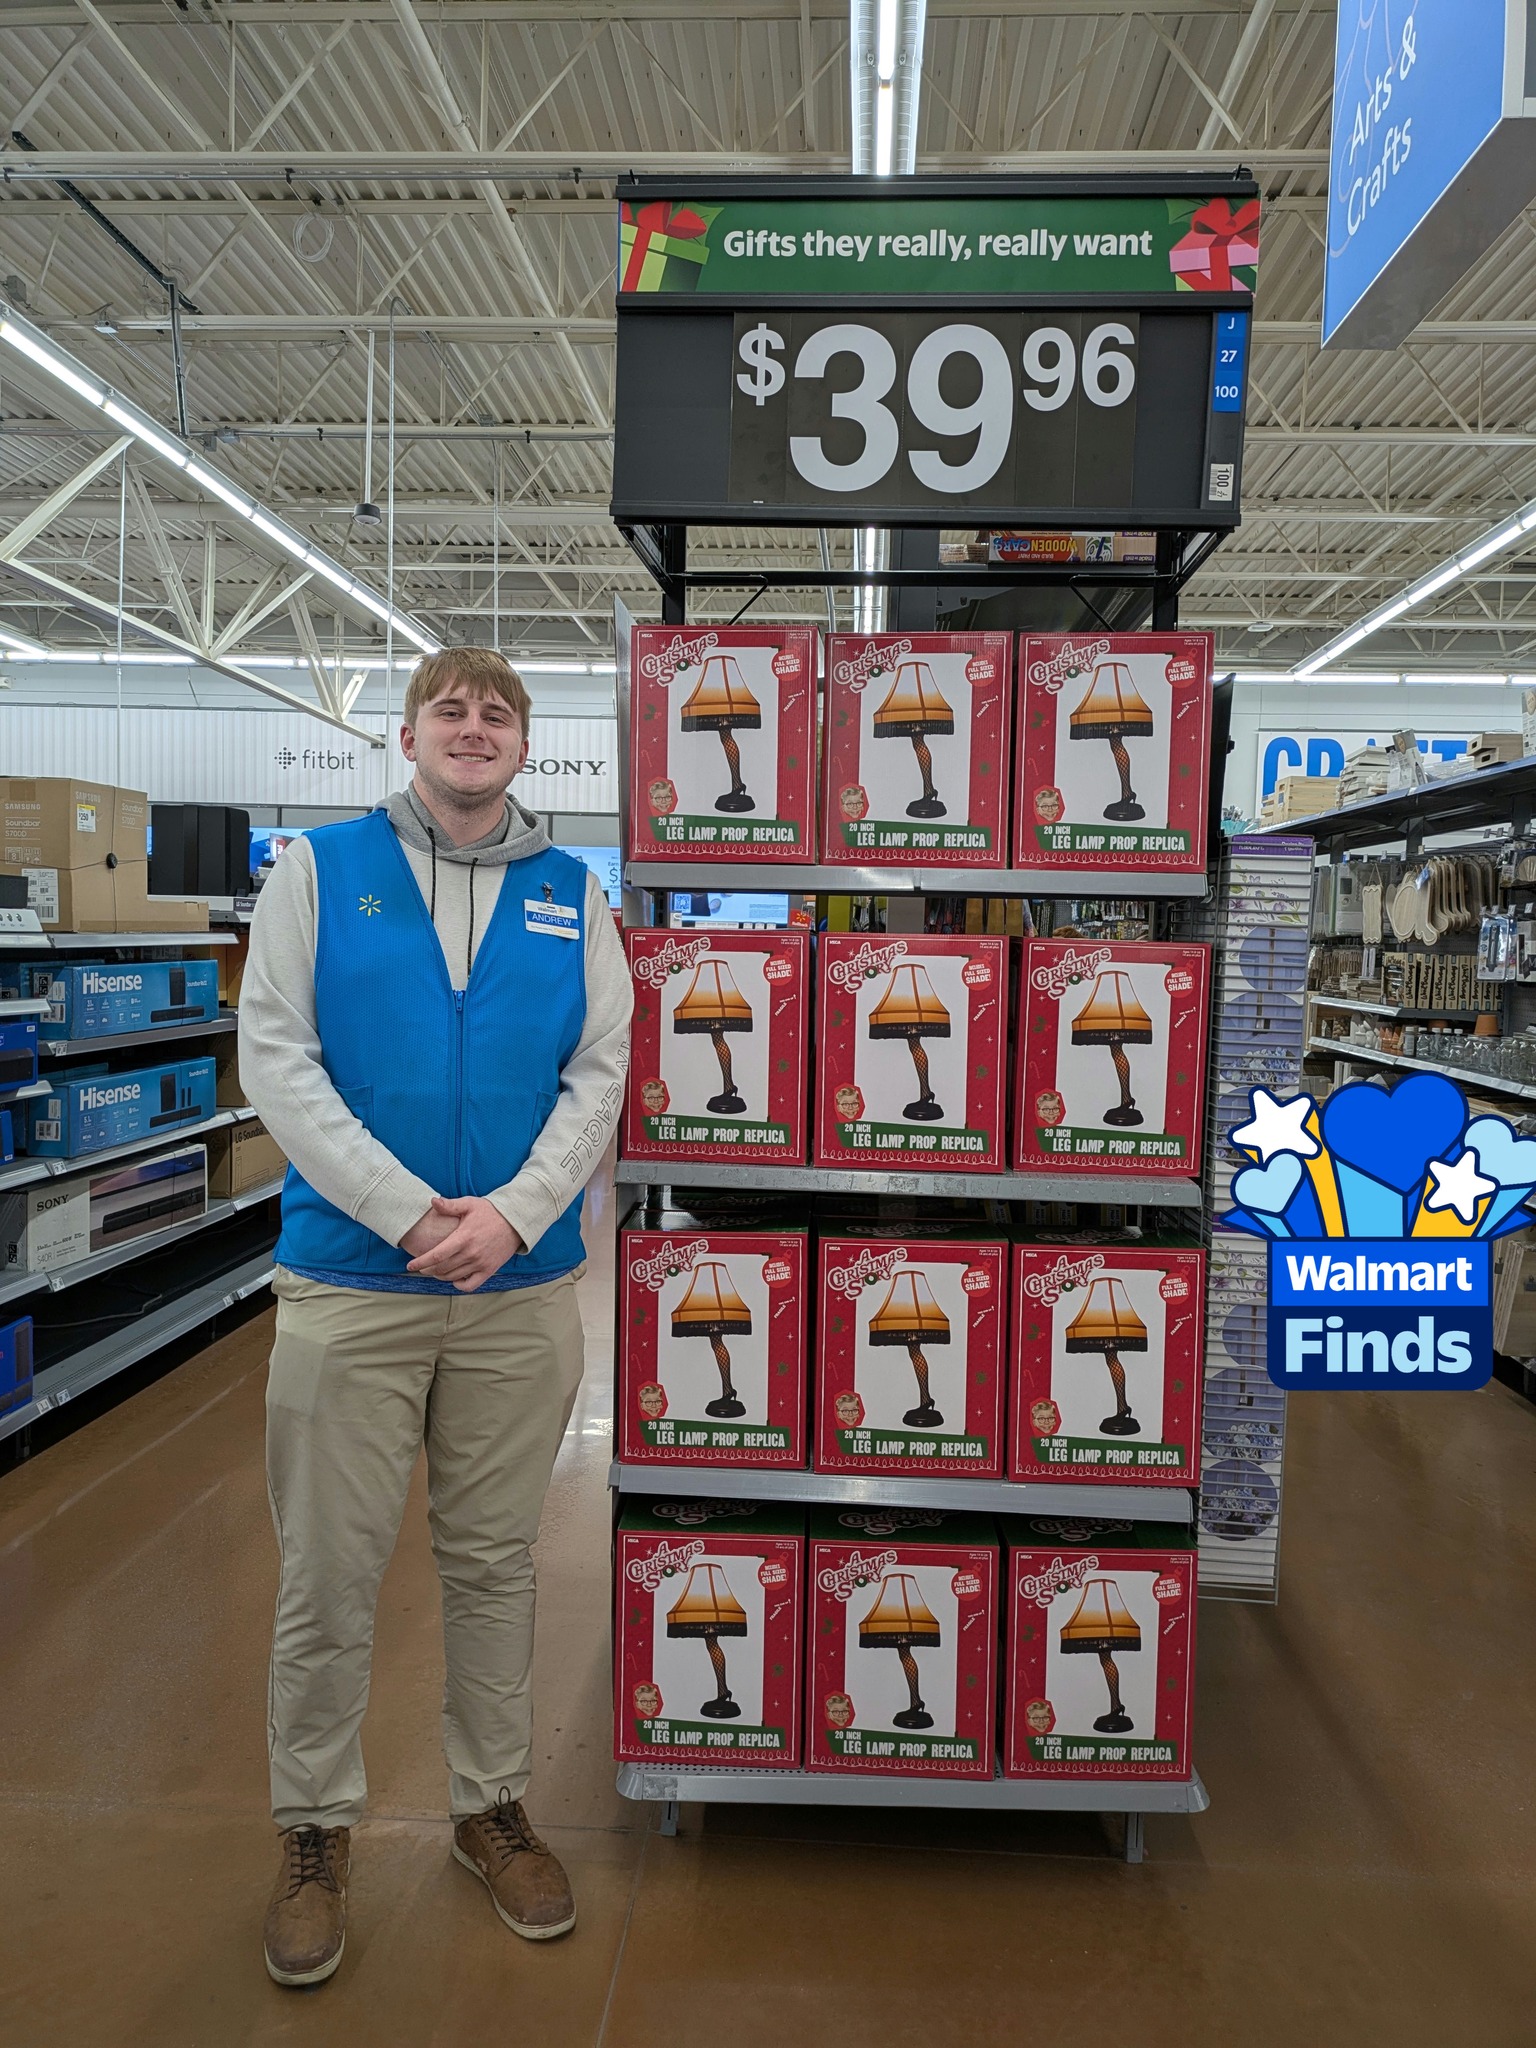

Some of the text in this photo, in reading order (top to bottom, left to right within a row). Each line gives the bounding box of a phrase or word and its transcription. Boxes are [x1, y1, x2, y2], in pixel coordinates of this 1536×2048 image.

[1349, 15, 1416, 166] Arts &
[1347, 117, 1412, 236] Crafts
[723, 229, 1153, 262] Gifts they really, really want
[1228, 317, 1235, 330] J
[1220, 350, 1238, 363] 27
[1214, 385, 1239, 398] 100
[1217, 468, 1229, 487] 100
[993, 536, 1078, 552] WOODEN CARS
[668, 635, 682, 653] A
[861, 642, 876, 659] A
[1058, 642, 1072, 660] A
[642, 635, 717, 677] CHRISTMAS
[835, 641, 911, 684] CHRISTMAS
[1030, 641, 1109, 684] CHRISTMAS
[302, 748, 356, 770] fitbit
[520, 758, 606, 776] SONY
[5, 820, 41, 828] Soundbar
[658, 817, 684, 826] 20 INCH
[849, 823, 875, 832] 20 INCH
[666, 826, 794, 842] LEG LAMP PROP REPLICA
[1044, 826, 1071, 835] 20 INCH
[857, 832, 986, 848] LEG LAMP PROP REPLICA
[1052, 835, 1185, 851] LEG LAMP PROP REPLICA
[532, 913, 572, 926] ANDREW
[661, 939, 675, 956] A
[856, 943, 871, 960] A
[635, 939, 709, 979] CHRISTMAS
[829, 943, 906, 984] CHRISTMAS
[1061, 949, 1075, 966] A
[1033, 950, 1110, 989] CHRISTMAS
[82, 973, 143, 995] Hisense
[79, 1083, 141, 1112] Hisense
[650, 1117, 676, 1126] 20 INCH
[845, 1123, 871, 1133] 20 INCH
[560, 1081, 622, 1183] EAGLE
[659, 1126, 785, 1144] LEG LAMP PROP REPLICA
[1045, 1129, 1071, 1138] 20 INCH
[853, 1132, 984, 1151] LEG LAMP PROP REPLICA
[1053, 1138, 1181, 1156] LEG LAMP PROP REPLICA
[36, 1194, 70, 1212] SONY
[658, 1241, 672, 1258] A
[856, 1249, 871, 1266] A
[632, 1241, 707, 1282] CHRISTMAS
[829, 1249, 906, 1290] CHRISTMAS
[1053, 1256, 1068, 1273] A
[1025, 1256, 1104, 1297] CHRISTMAS
[648, 1421, 675, 1430] 20 INCH
[657, 1430, 785, 1448] LEG LAMP PROP REPLICA
[845, 1430, 871, 1439] 20 INCH
[1041, 1438, 1067, 1447] 20 INCH
[853, 1439, 983, 1457] LEG LAMP PROP REPLICA
[1049, 1447, 1180, 1465] LEG LAMP PROP REPLICA
[654, 1542, 668, 1559] A
[627, 1542, 703, 1582] CHRISTMAS
[846, 1552, 861, 1569] A
[1048, 1558, 1062, 1575] A
[819, 1552, 896, 1592] CHRISTMAS
[1020, 1558, 1098, 1598] CHRISTMAS
[643, 1720, 670, 1729] 20 INCH
[652, 1729, 780, 1748] LEG LAMP PROP REPLICA
[835, 1731, 862, 1740] 20 INCH
[1035, 1737, 1062, 1745] 20 INCH
[844, 1740, 973, 1759] LEG LAMP PROP REPLICA
[1044, 1746, 1172, 1761] LEG LAMP PROP REPLICA
